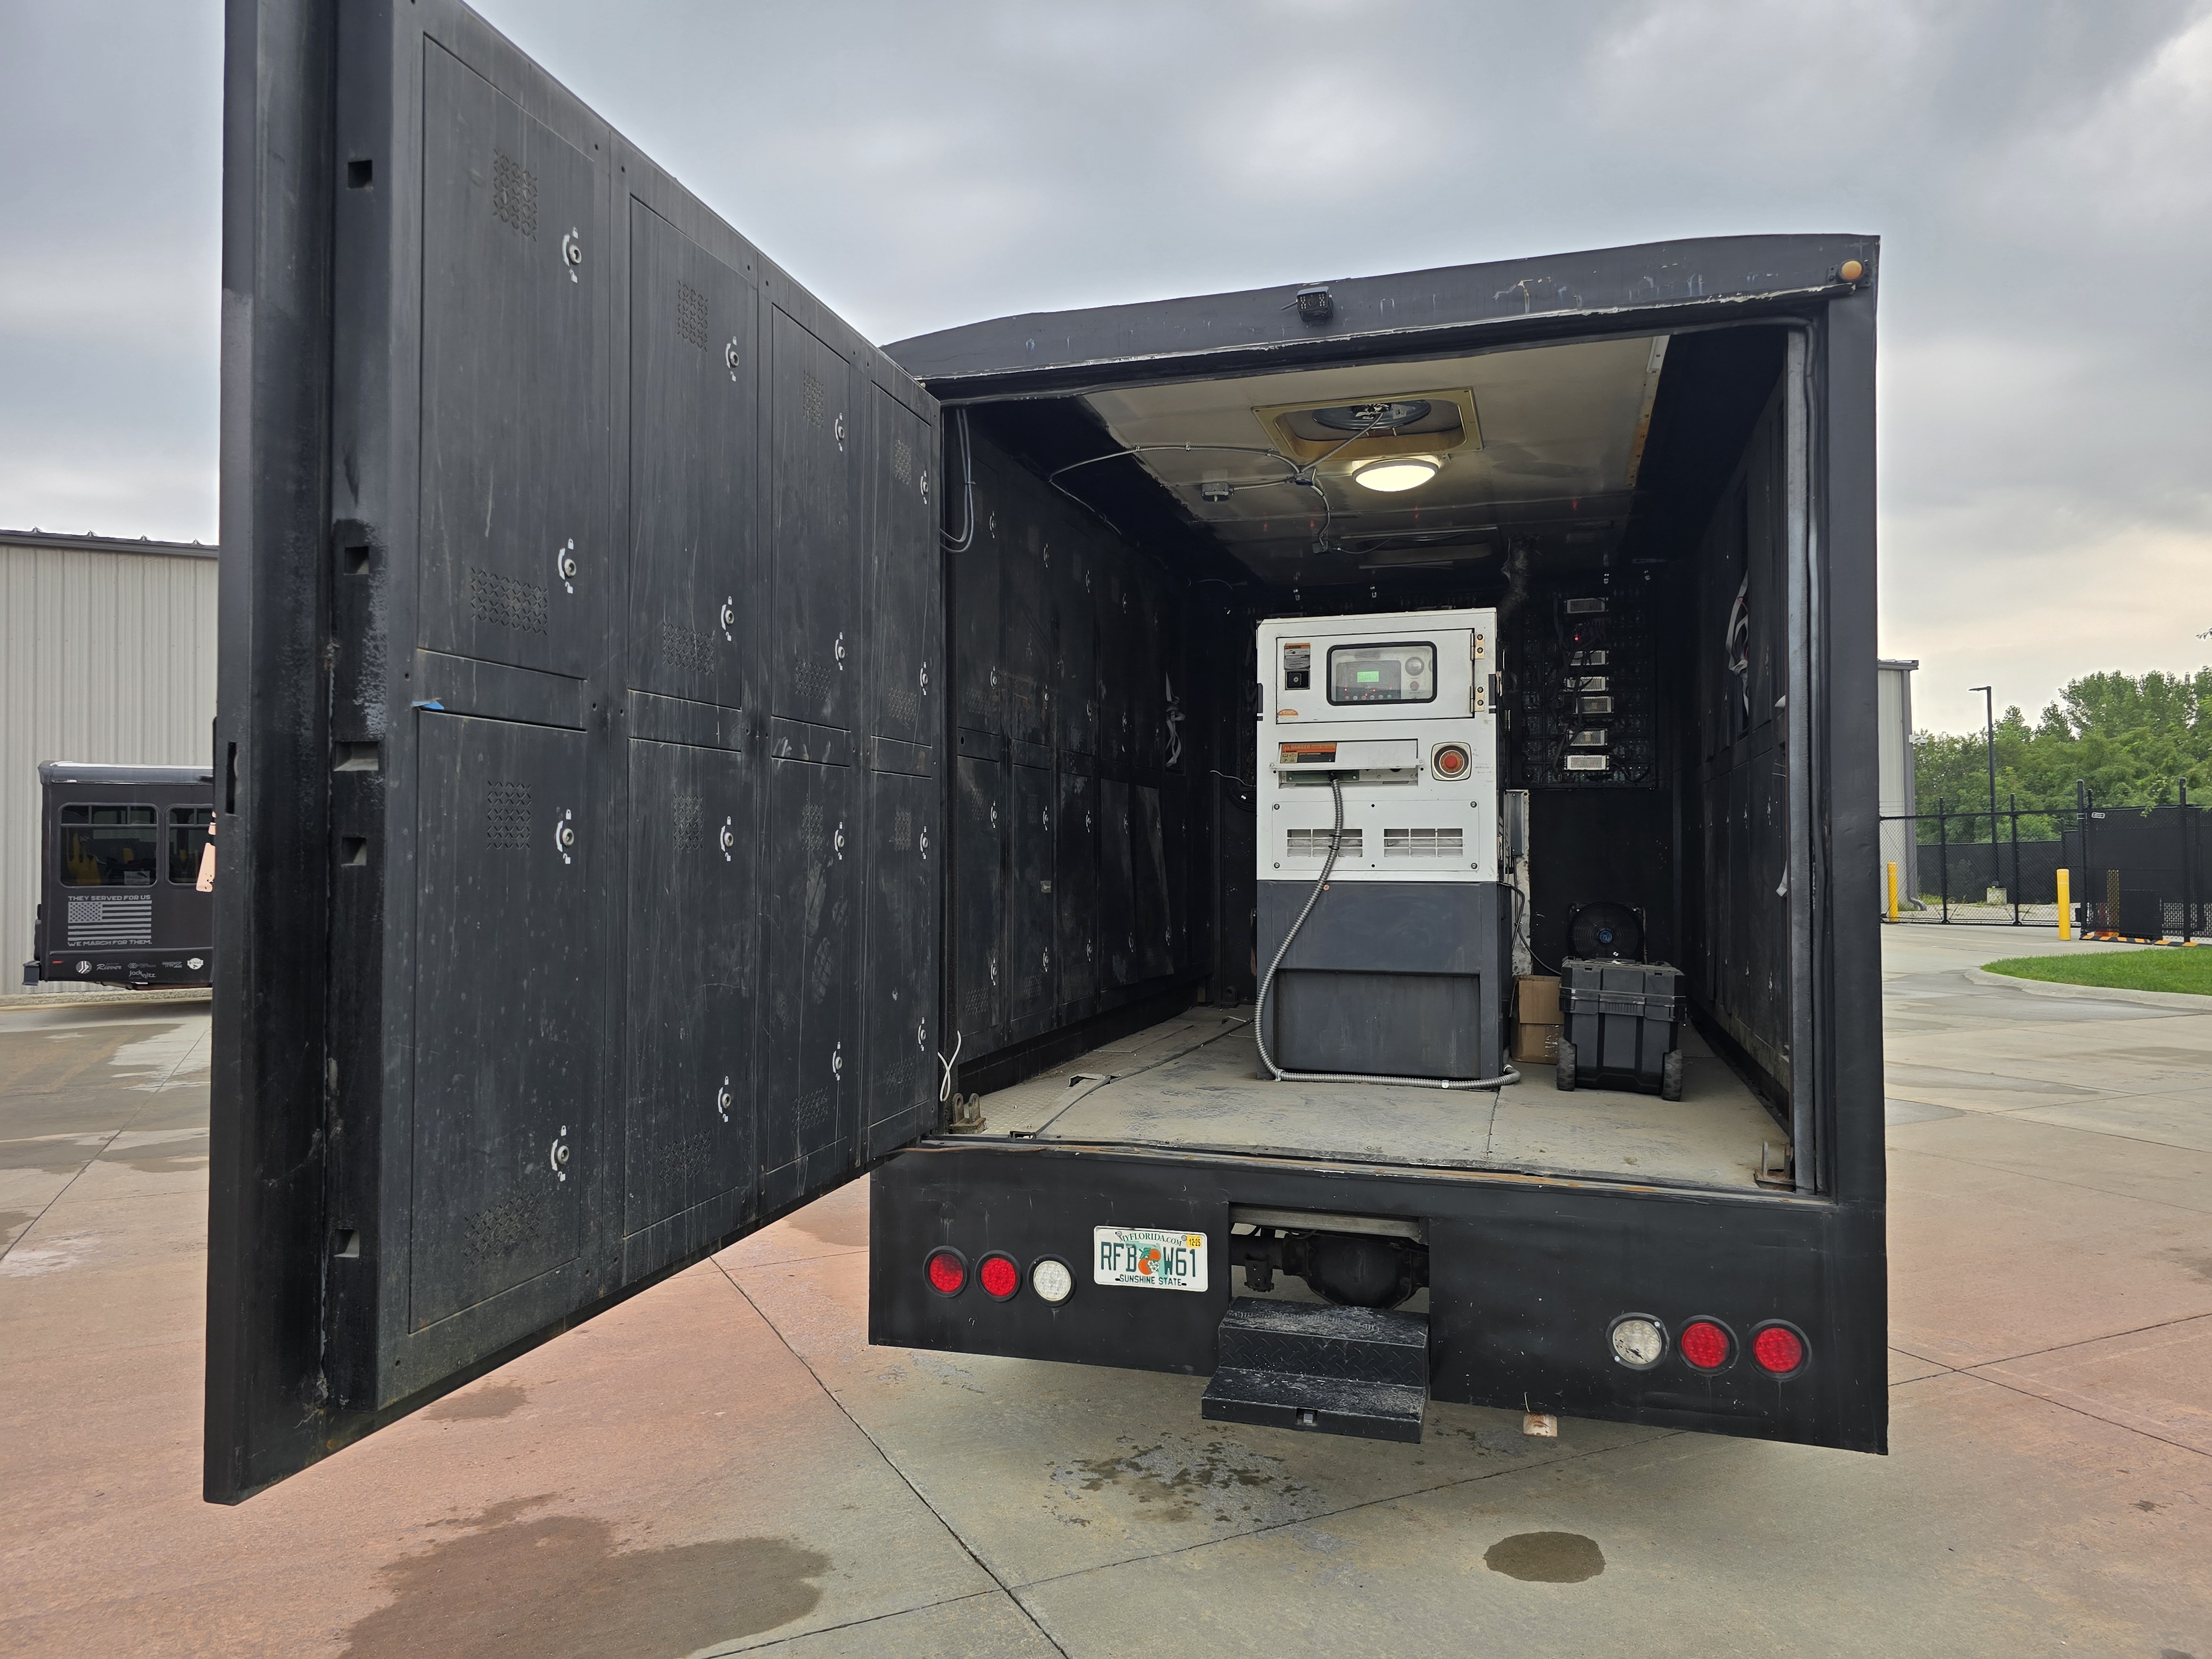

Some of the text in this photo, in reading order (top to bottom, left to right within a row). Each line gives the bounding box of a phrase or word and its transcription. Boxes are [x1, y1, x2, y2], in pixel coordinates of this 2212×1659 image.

[1119, 1233, 1182, 1246] MYFLORIDA.COM
[1188, 1238, 1201, 1246] 12-25
[1100, 1241, 1196, 1277] RFB W61
[1119, 1274, 1182, 1286] SUNSHINE STATE
